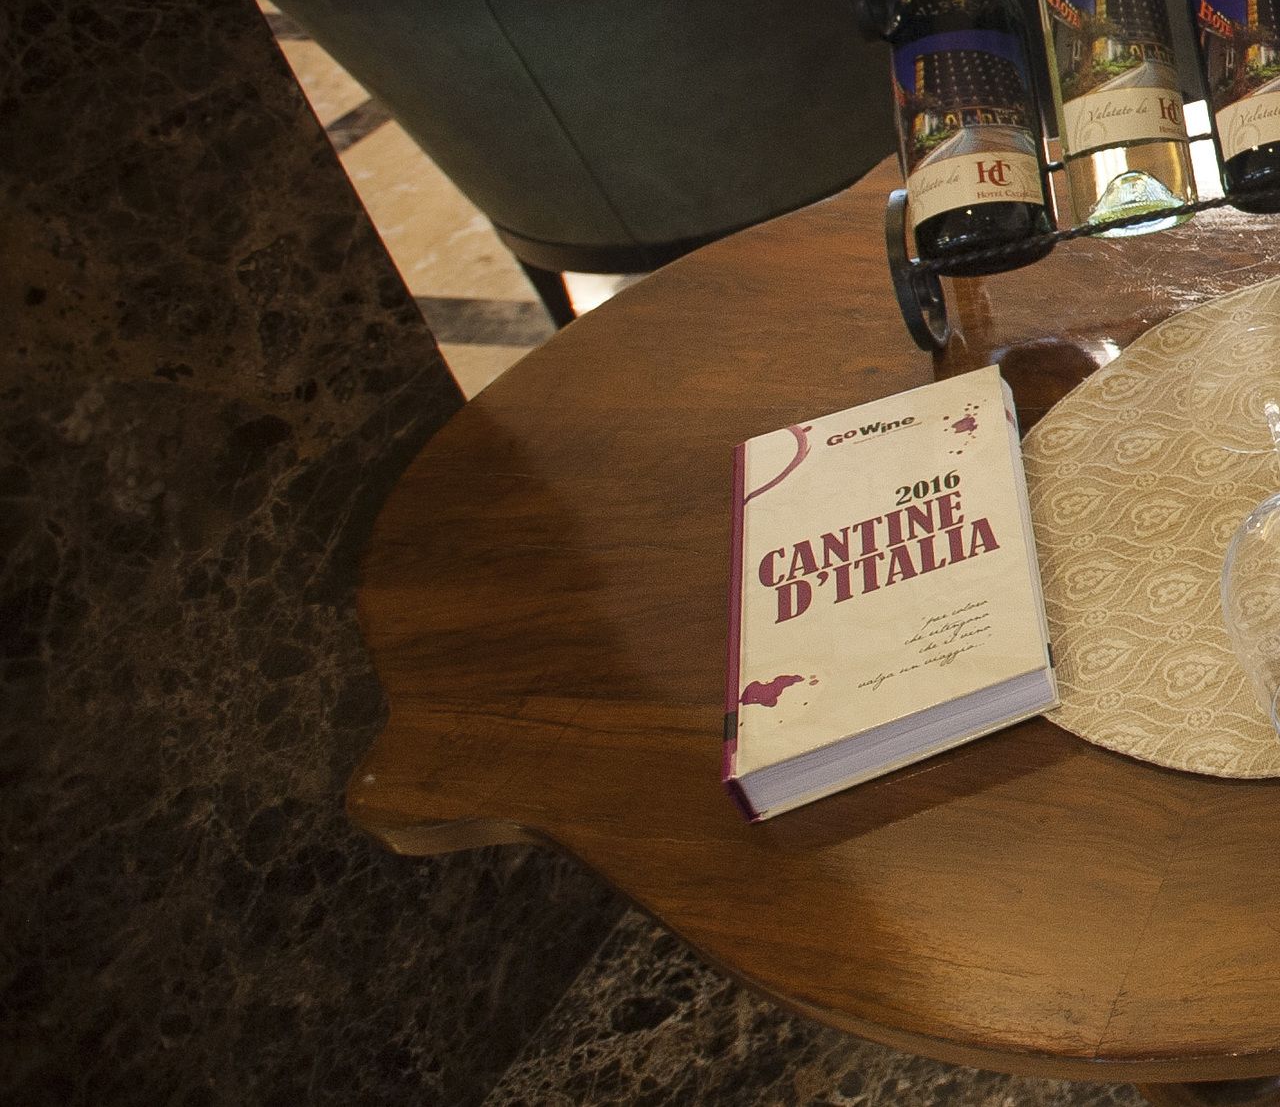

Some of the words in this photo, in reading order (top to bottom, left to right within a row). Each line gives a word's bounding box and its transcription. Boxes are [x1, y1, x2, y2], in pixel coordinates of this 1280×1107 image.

[895, 470, 961, 506] 2016
[758, 491, 965, 588] CANTINE
[774, 518, 1001, 625] D'ITALIA
